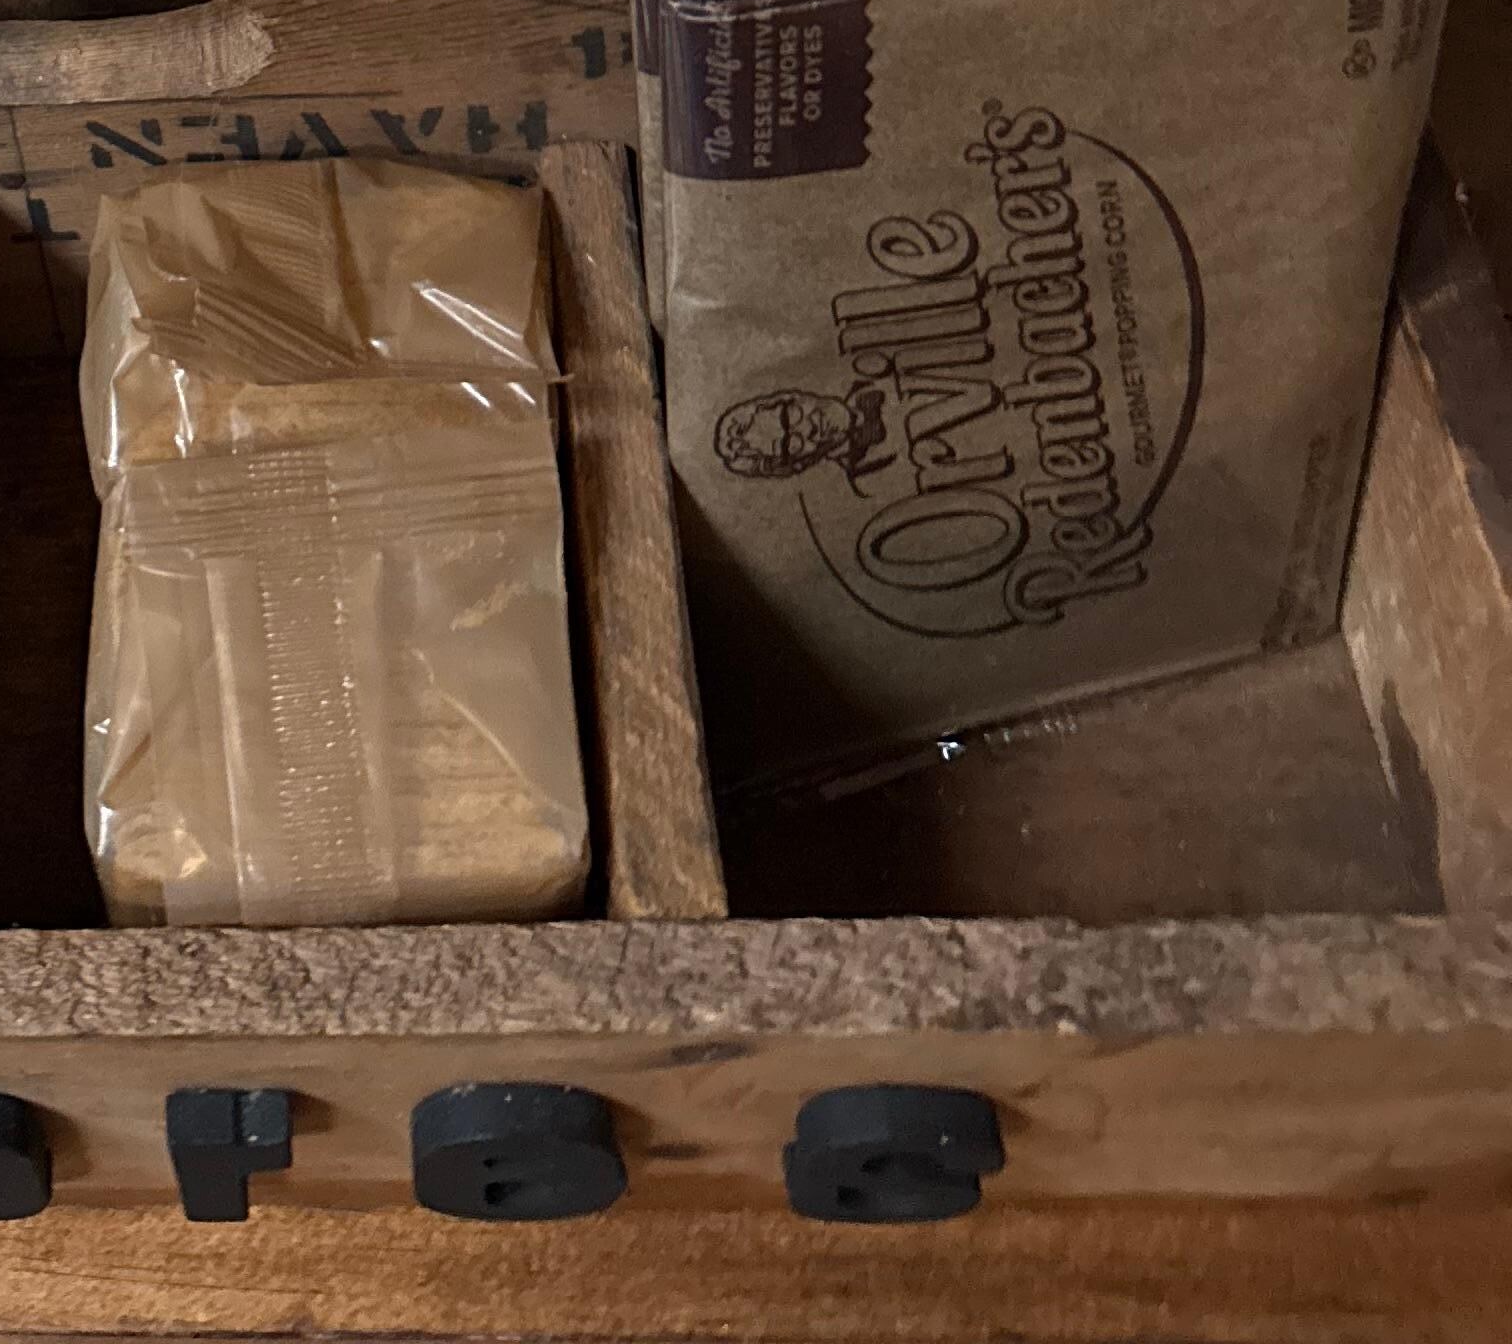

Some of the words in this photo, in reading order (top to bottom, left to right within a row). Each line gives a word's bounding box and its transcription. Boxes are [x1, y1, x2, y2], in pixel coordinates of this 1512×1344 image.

[778, 24, 799, 127] FLAVORS
[803, 24, 824, 84] DYES
[704, 124, 734, 163] No
[803, 89, 822, 122] OR
[1095, 179, 1126, 248] CORN
[1106, 251, 1139, 346] POPPING
[831, 209, 1030, 591] Orville
[964, 106, 1153, 624] Redenbacher's
